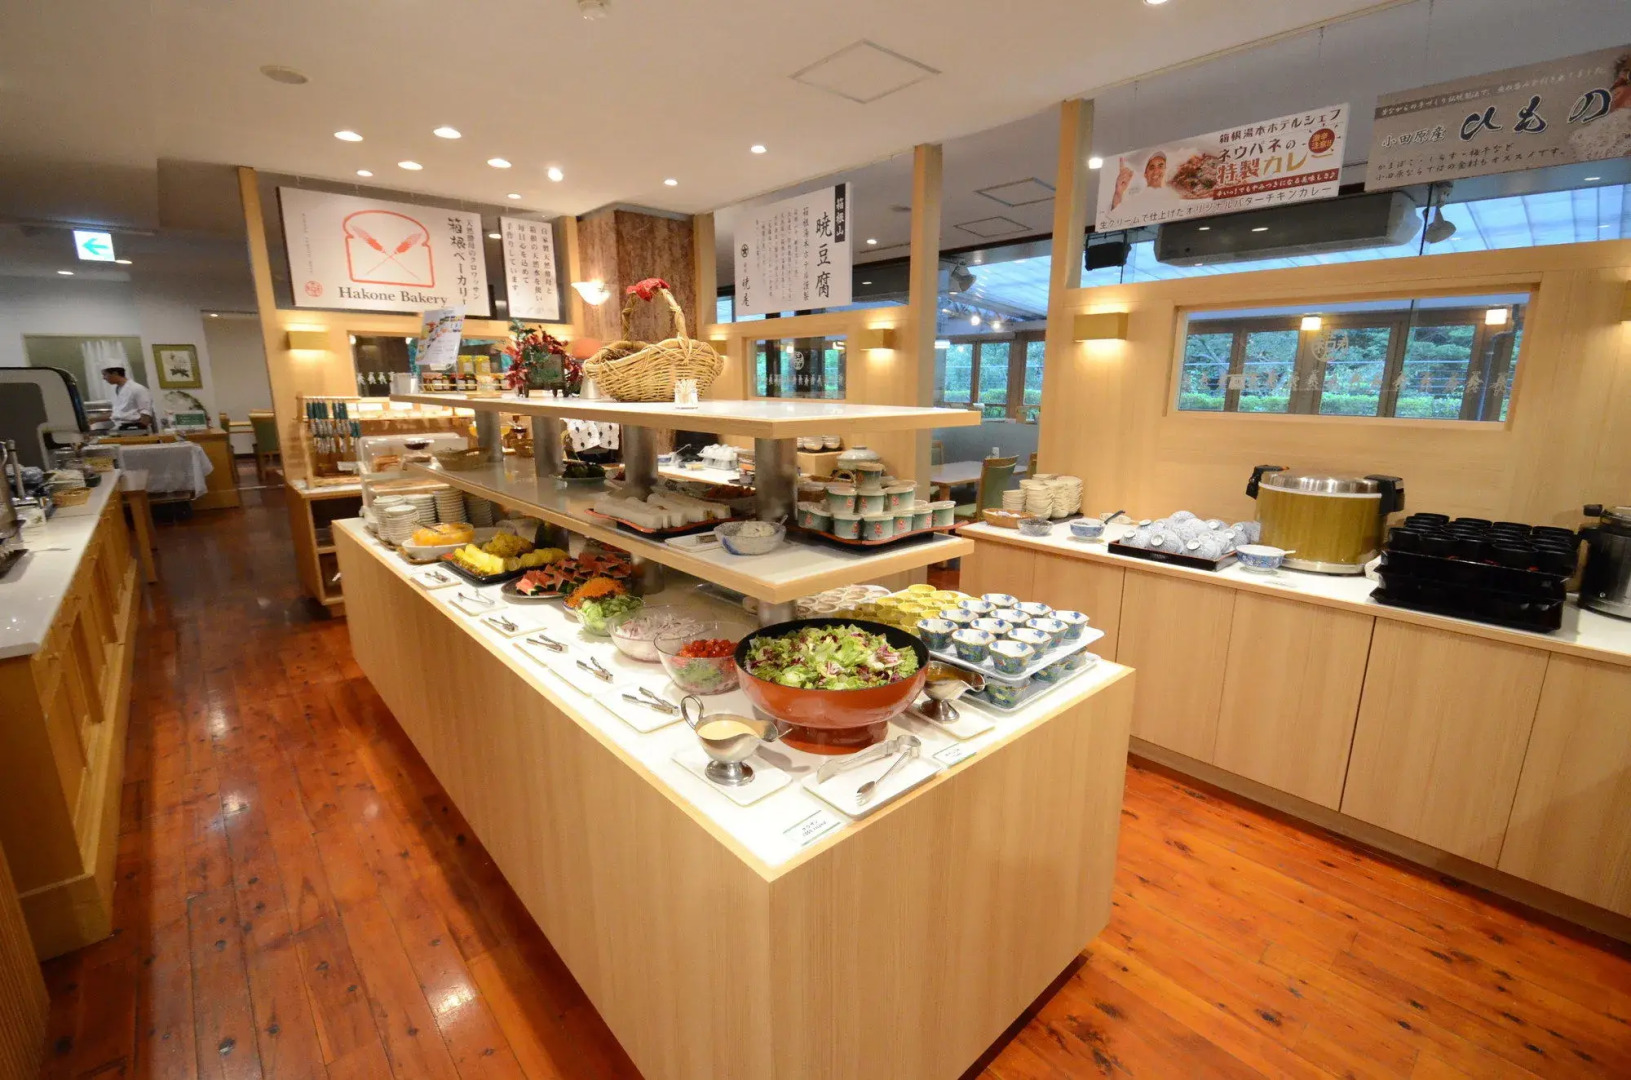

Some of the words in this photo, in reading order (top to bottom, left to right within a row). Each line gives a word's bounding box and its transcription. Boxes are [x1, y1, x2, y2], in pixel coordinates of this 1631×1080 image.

[1219, 108, 1342, 144] 箱根湯本ホテルシェフ
[1459, 88, 1612, 141] ひもの
[1381, 125, 1447, 148] 小田原産
[1217, 152, 1333, 184] 特製カレー
[338, 286, 396, 302] Hakone
[399, 290, 448, 308] Bakery
